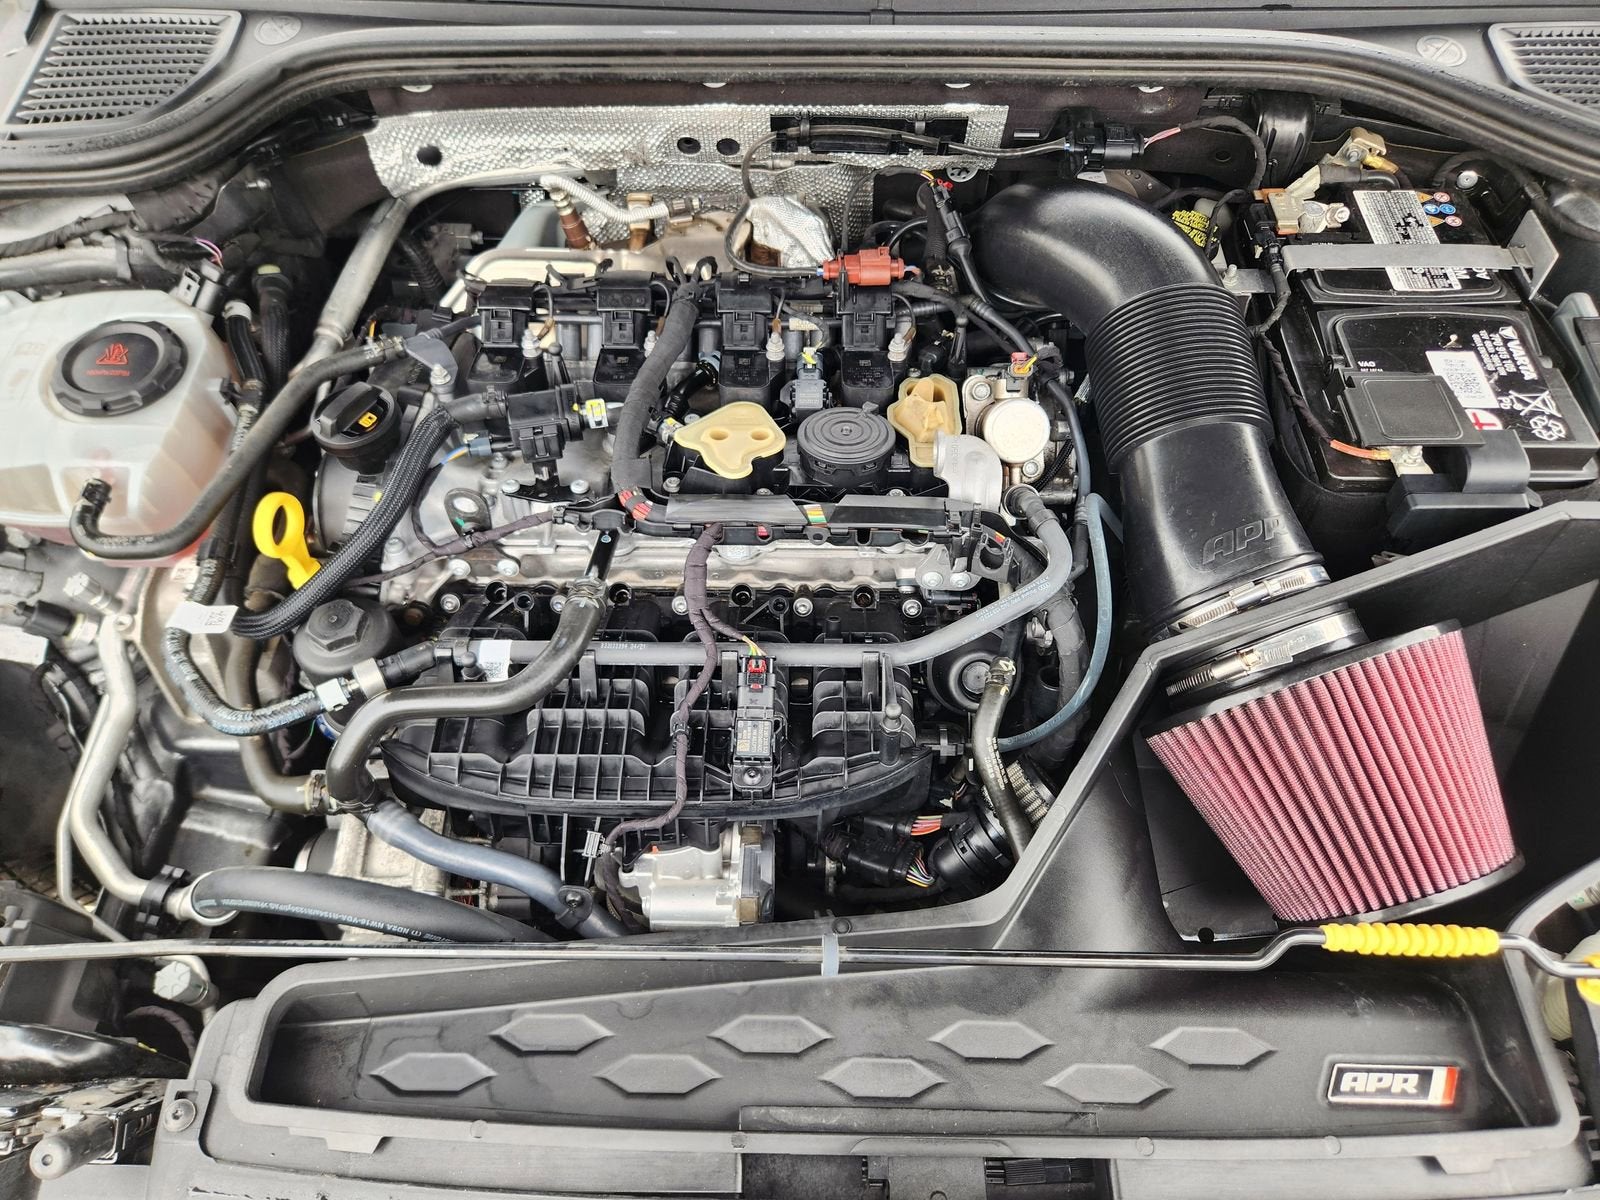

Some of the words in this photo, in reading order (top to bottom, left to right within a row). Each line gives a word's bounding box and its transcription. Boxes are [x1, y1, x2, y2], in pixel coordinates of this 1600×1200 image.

[1507, 339, 1538, 380] VARTA
[1202, 515, 1289, 565] APR
[1339, 1072, 1419, 1094] APR
